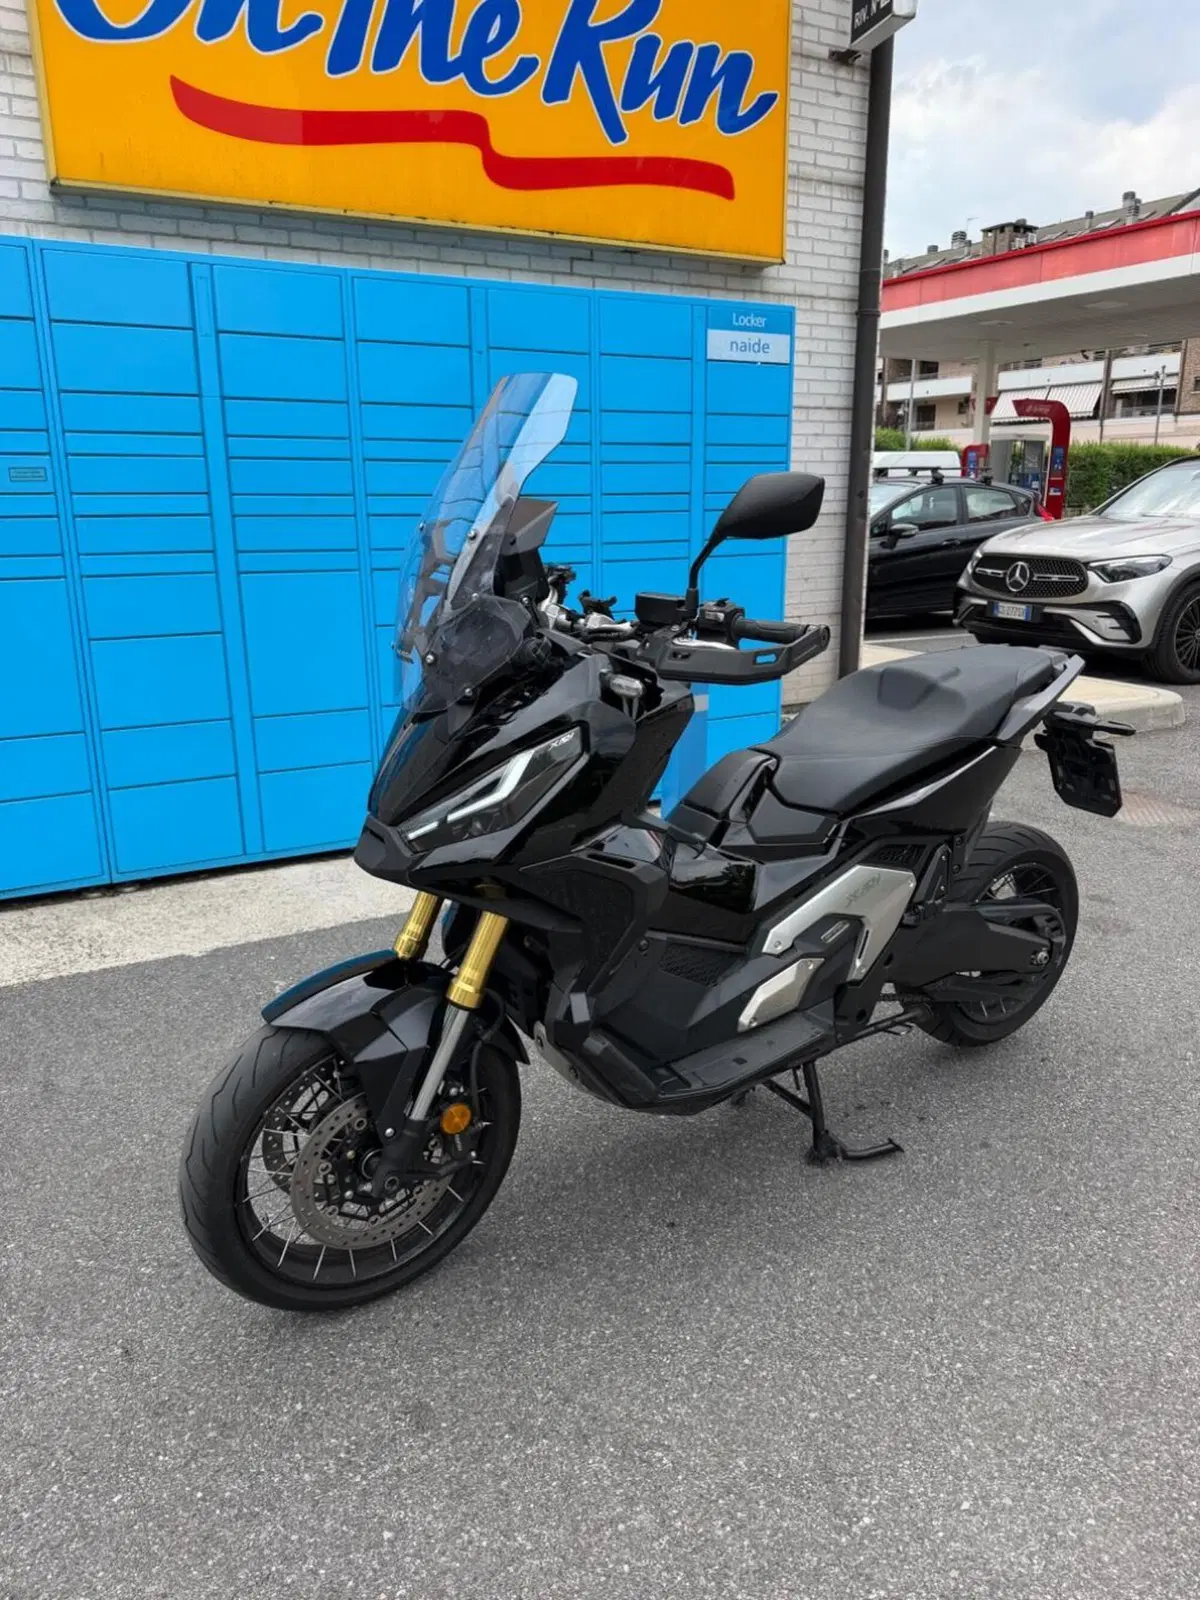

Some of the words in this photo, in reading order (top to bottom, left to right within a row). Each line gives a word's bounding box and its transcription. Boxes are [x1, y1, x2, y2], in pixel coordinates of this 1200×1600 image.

[541, 0, 779, 146] Run
[732, 312, 768, 328] Locker
[730, 338, 771, 354] naide
